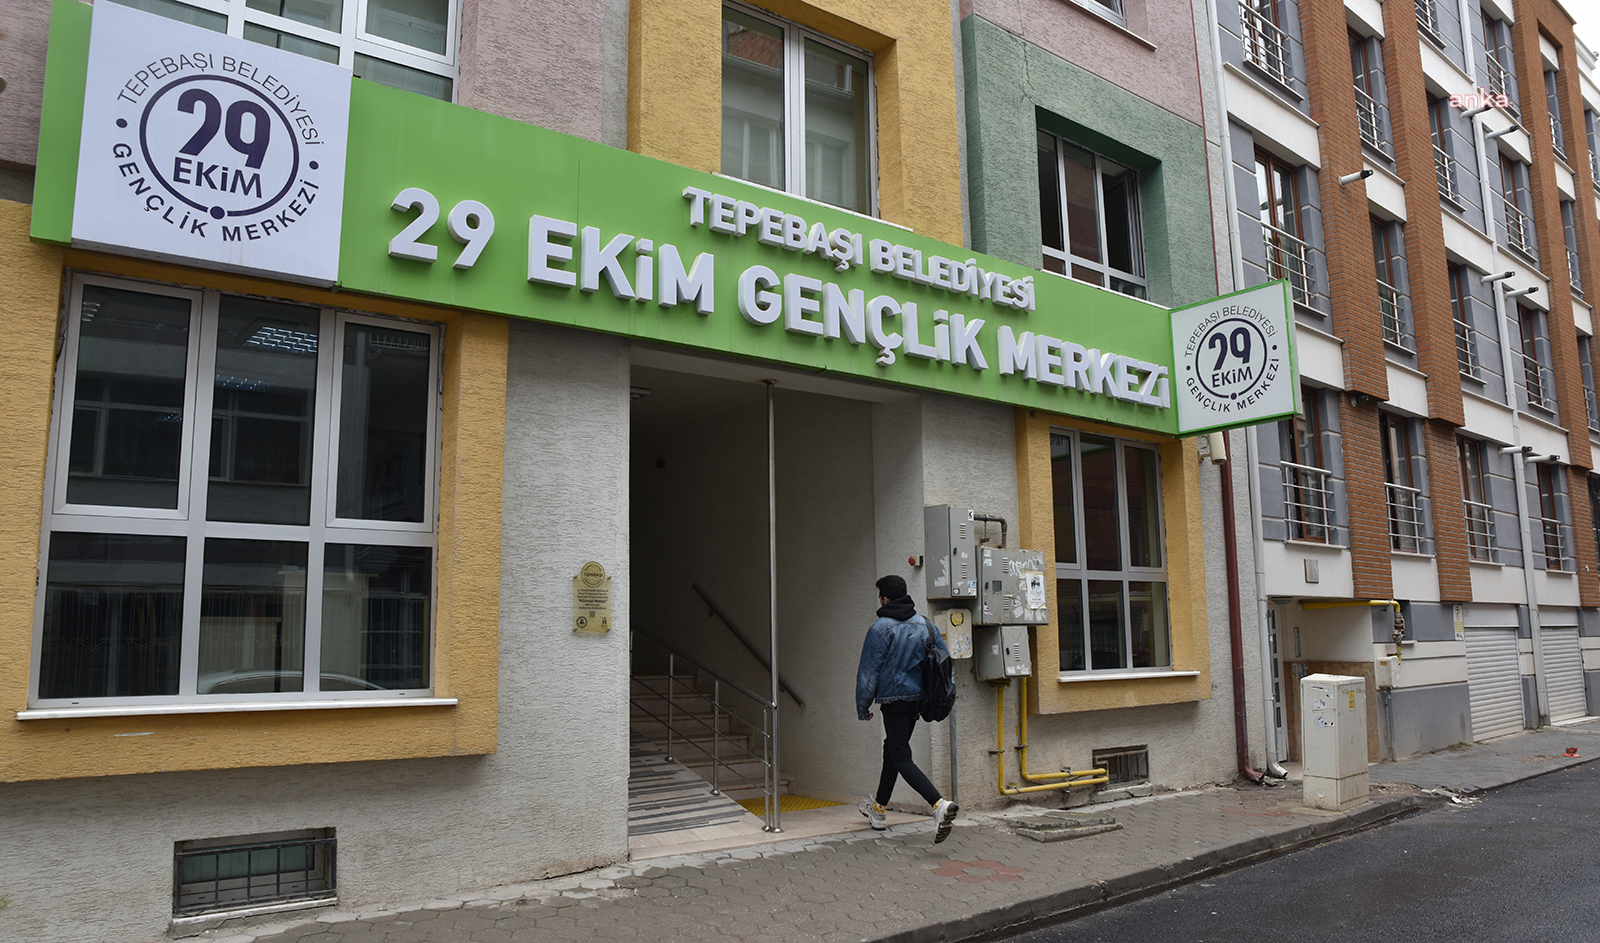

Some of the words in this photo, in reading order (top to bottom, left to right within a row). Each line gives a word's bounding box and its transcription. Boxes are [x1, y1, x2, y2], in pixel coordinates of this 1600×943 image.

[117, 52, 214, 104] TEPEBAŞI
[222, 55, 324, 146] BELEDİYESİ
[177, 88, 271, 169] 29
[112, 142, 209, 238] GENÇLİK
[222, 178, 320, 242] MERKEZİ
[388, 187, 495, 270] 29
[682, 186, 863, 272] TEPEBAŞI
[869, 238, 1036, 313] BELEDİYESİ
[1184, 310, 1220, 358] TEPEBAŞI
[1222, 305, 1279, 338] BELEDİYESİ
[1208, 326, 1251, 372] 29
[1236, 357, 1280, 411] MERKEZİ
